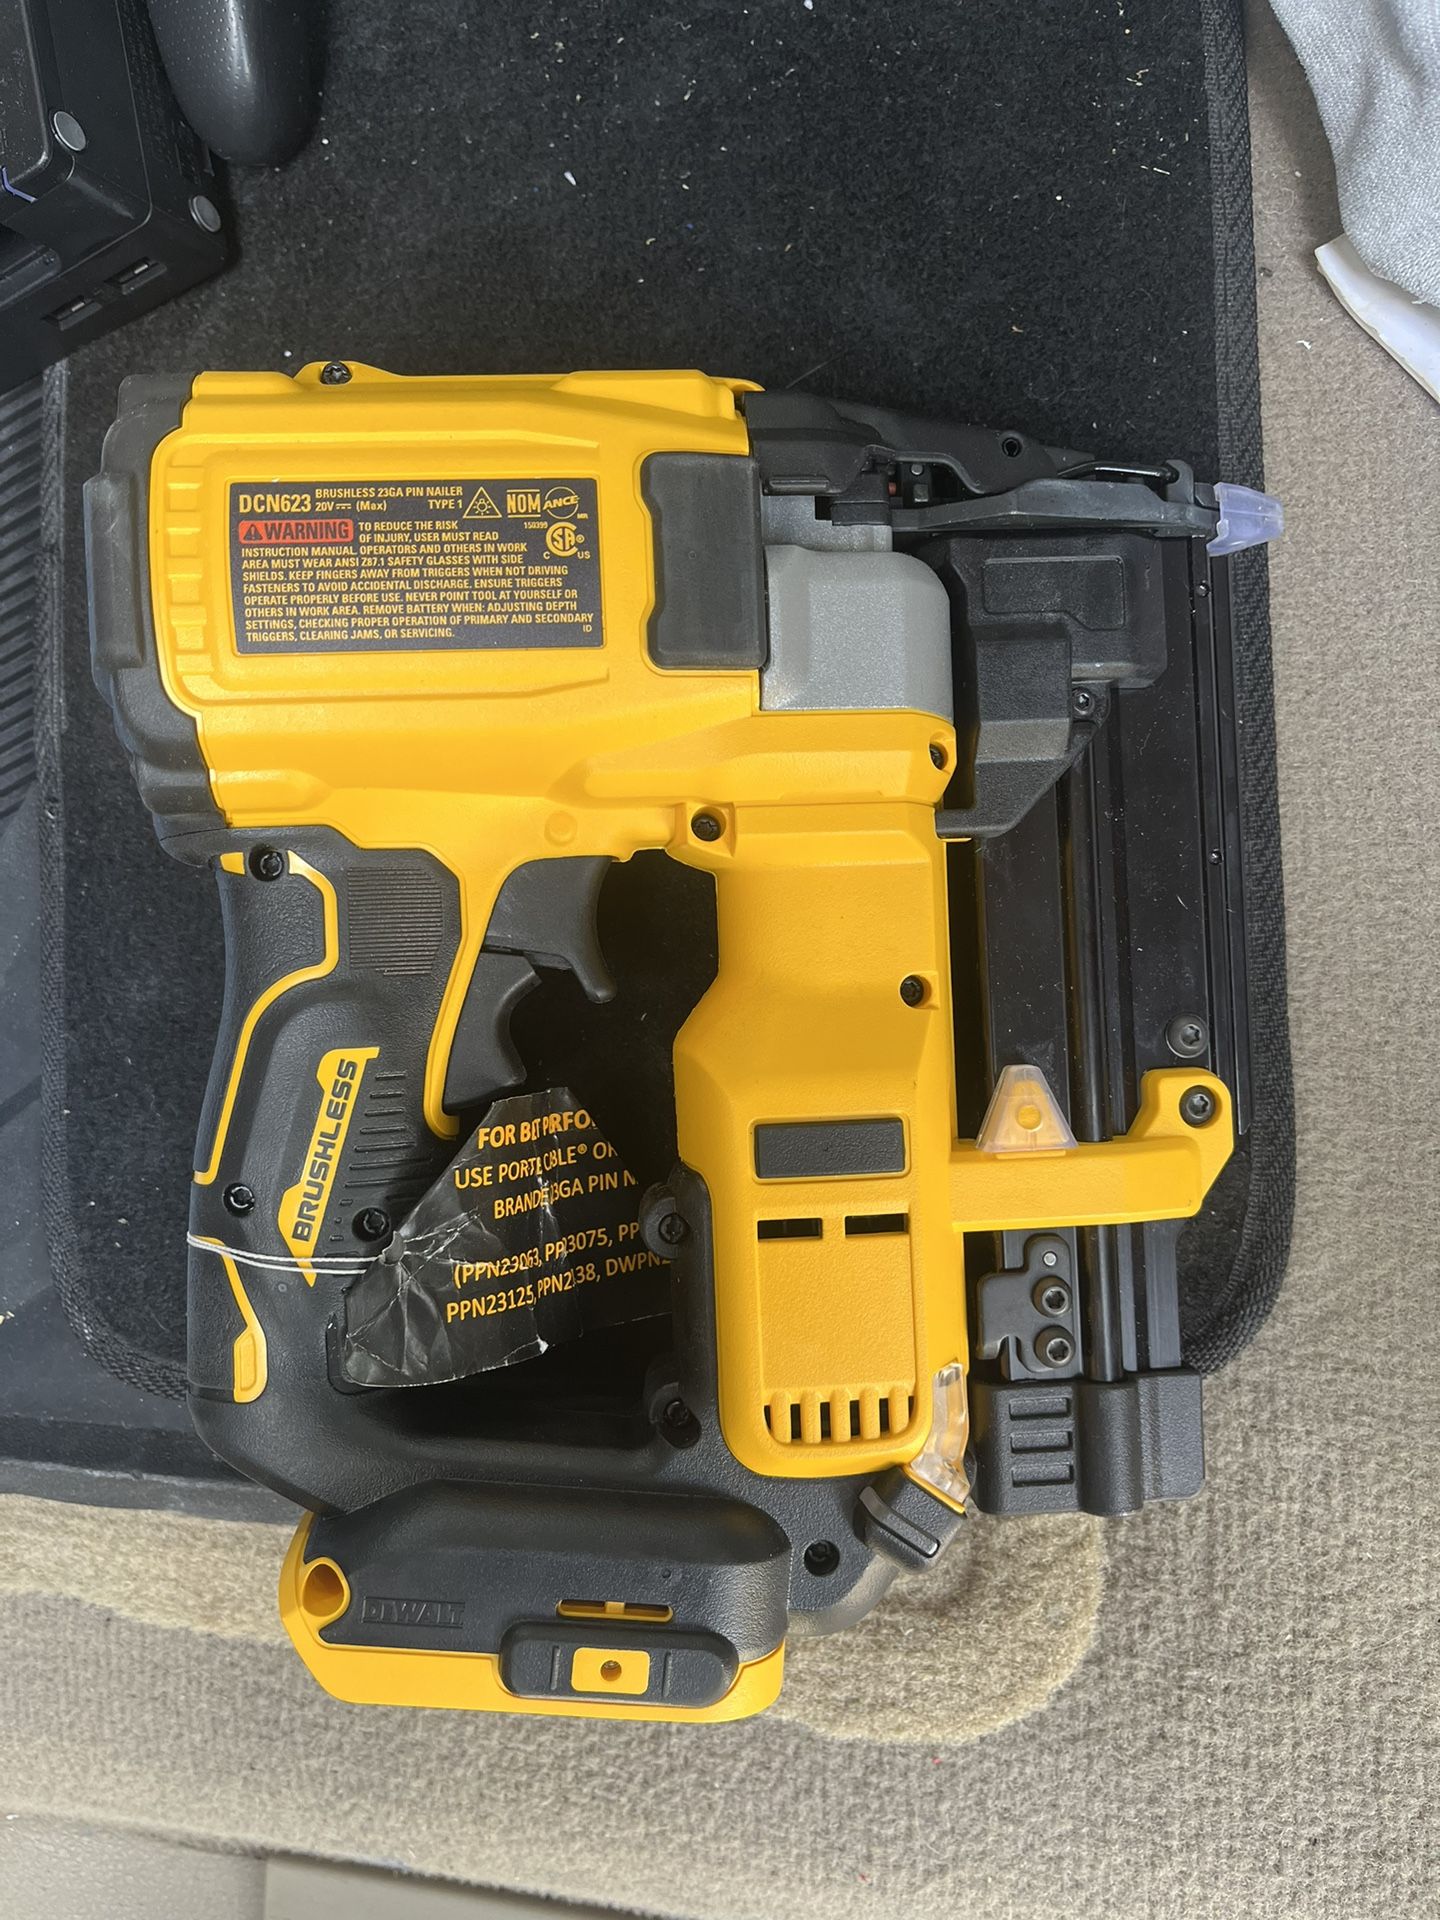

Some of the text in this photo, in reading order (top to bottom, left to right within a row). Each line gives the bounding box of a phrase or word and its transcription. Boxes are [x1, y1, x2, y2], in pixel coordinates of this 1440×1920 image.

[315, 486, 463, 498] BRUSHLESS 23GA PIN NAILER
[239, 494, 312, 512] DCN623
[315, 500, 387, 512] 20V (Max)
[428, 500, 463, 509] TYPE 1
[506, 494, 541, 513] NOM
[543, 495, 580, 510] ANCE
[264, 521, 350, 540] WARNING
[358, 520, 458, 531] TO REDUCE THE RISK
[359, 531, 499, 544] OF INJURY, USER MUST READ
[241, 547, 309, 557] INSTRUCTION
[359, 545, 418, 555] OPERATORS
[418, 544, 441, 554] AND
[444, 544, 482, 553] OTHERS
[484, 543, 496, 552] IN
[497, 543, 528, 552] WORK
[577, 551, 590, 559] US
[241, 555, 524, 569] AREA MUST WEAR ANSI Z87.1 SAFETY GLASSES WITH SIDE
[242, 566, 568, 581] SHIELDS. KEEP FINGERS AWAY FROM TRIGGERS WHEN NOT DRIVING
[243, 578, 563, 593] FASTENERS TO AVOID ACCIDENTAL DISCHARGE. ENSURE TRIGGERS
[244, 590, 578, 605] OPERATE PROPERLY BEFORE USE. NEVER POINT TOOL AT YOURSELF OR
[244, 602, 577, 617] OTHERS IN WORK AREA. REMOVE BATTERY WHEN: ADJUSTING DEPTH
[245, 613, 594, 630] SETTINGS, CHECKING PROPER OPERATION OF PRIMARY AND SECONDARY
[246, 628, 455, 642] TRIGGERS, CLEARING JAMS, OR SERVICING.
[478, 1124, 516, 1150] FOR
[292, 1058, 358, 1242] BRUSHLESS
[454, 1166, 493, 1190] USE
[588, 1172, 618, 1192] PIN
